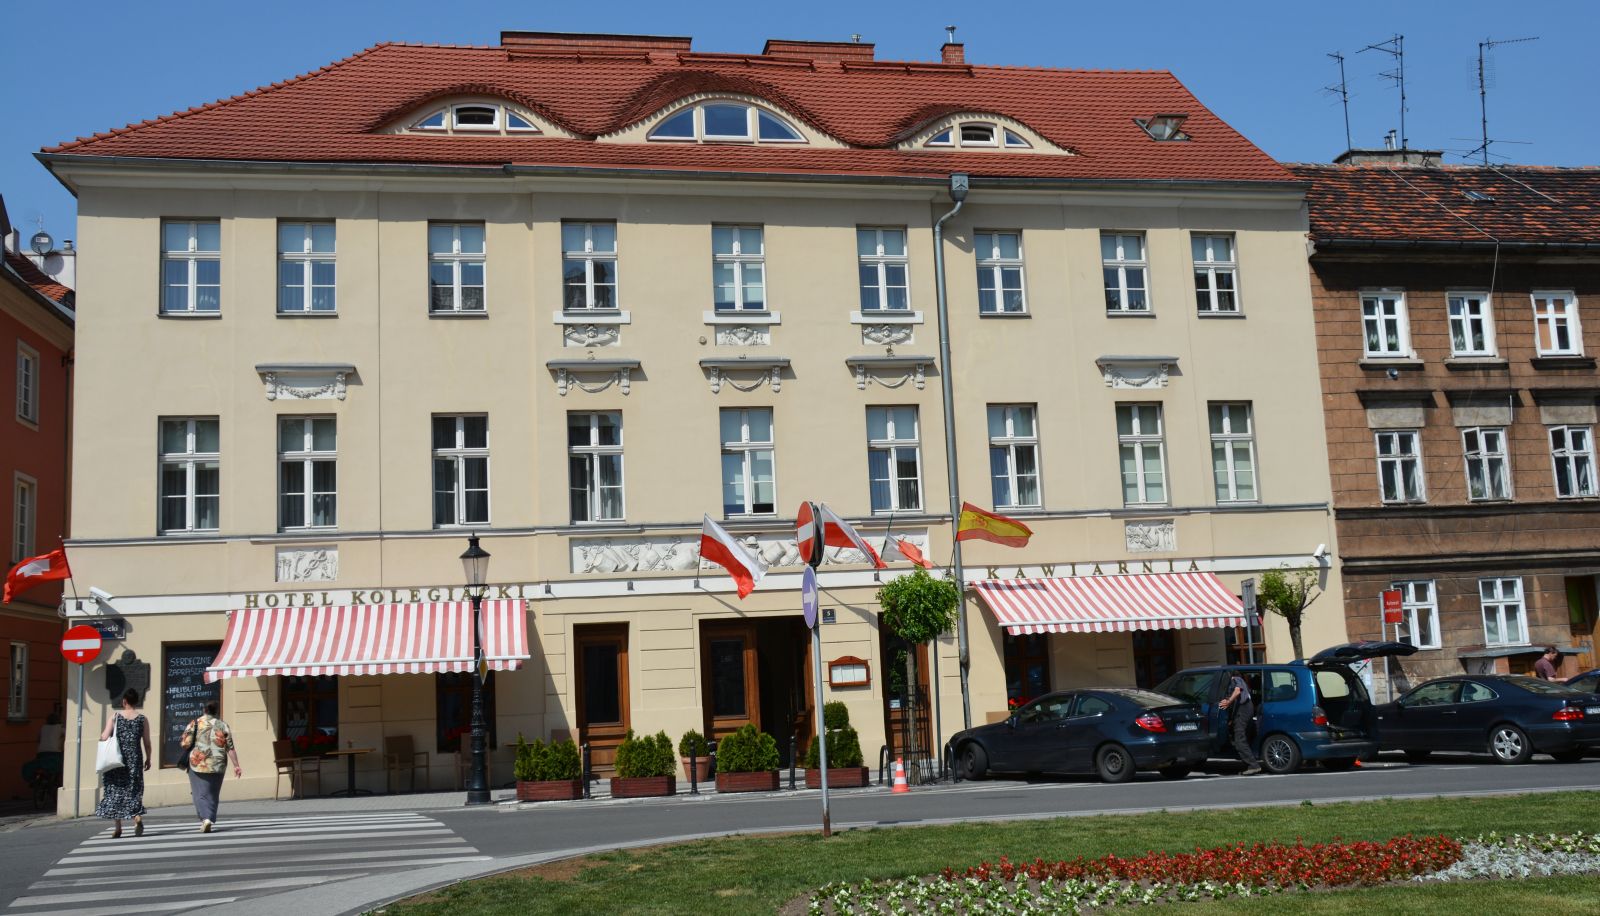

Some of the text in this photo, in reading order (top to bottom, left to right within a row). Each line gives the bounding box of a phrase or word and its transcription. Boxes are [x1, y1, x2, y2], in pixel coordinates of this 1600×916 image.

[987, 560, 1199, 579] KAWIARNIA
[245, 585, 524, 608] HOTEL KOLEGIACKI
[170, 656, 212, 667] SERDECZNIE
